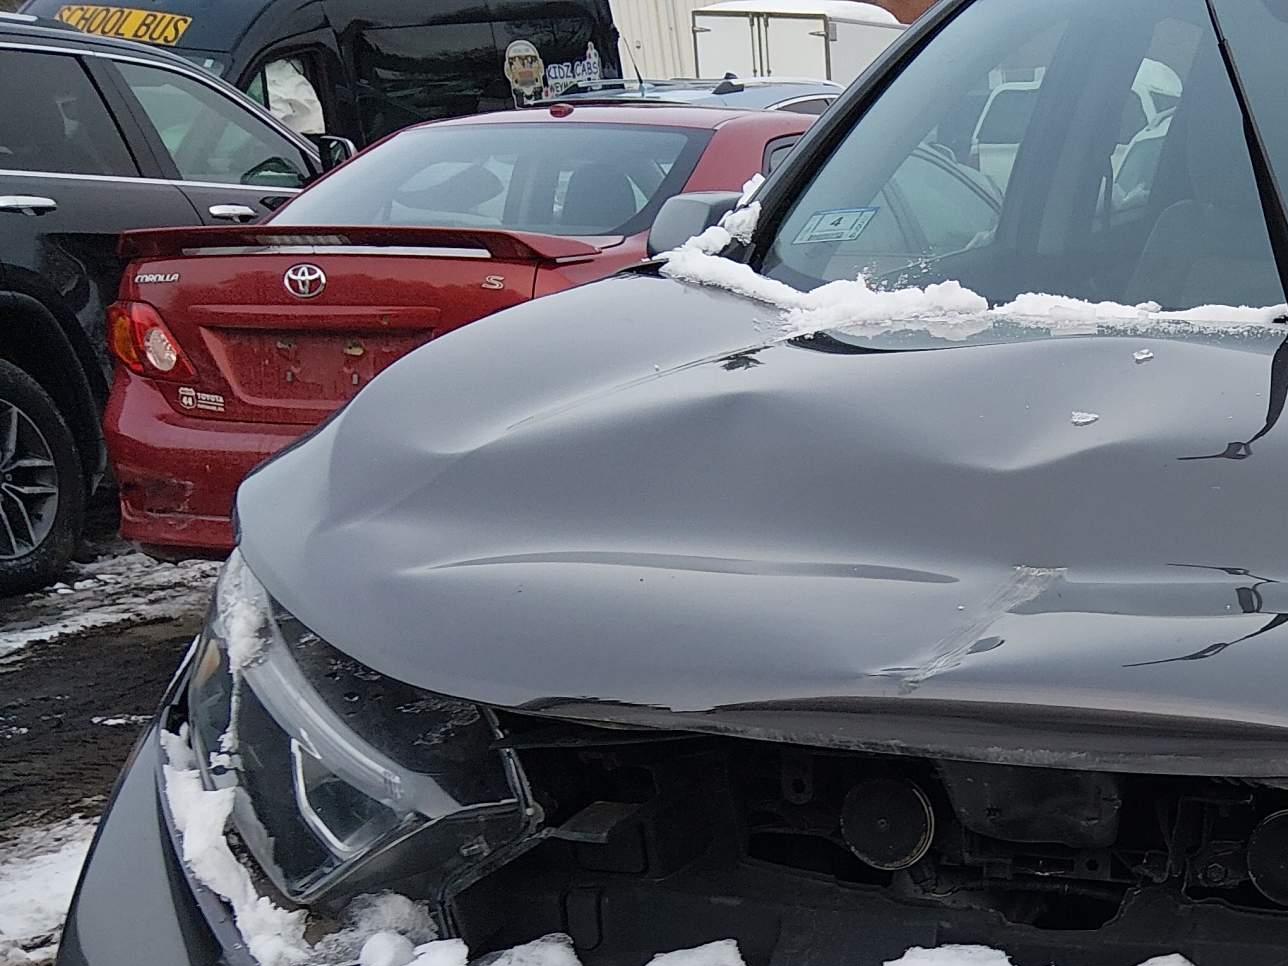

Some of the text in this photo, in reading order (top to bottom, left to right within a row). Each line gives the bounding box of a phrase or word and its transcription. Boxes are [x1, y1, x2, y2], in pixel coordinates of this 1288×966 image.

[132, 12, 188, 43] BUS
[548, 62, 599, 79] KIDZ CABS
[829, 216, 845, 227] 4
[134, 273, 180, 283] COROLLA
[481, 275, 505, 289] S
